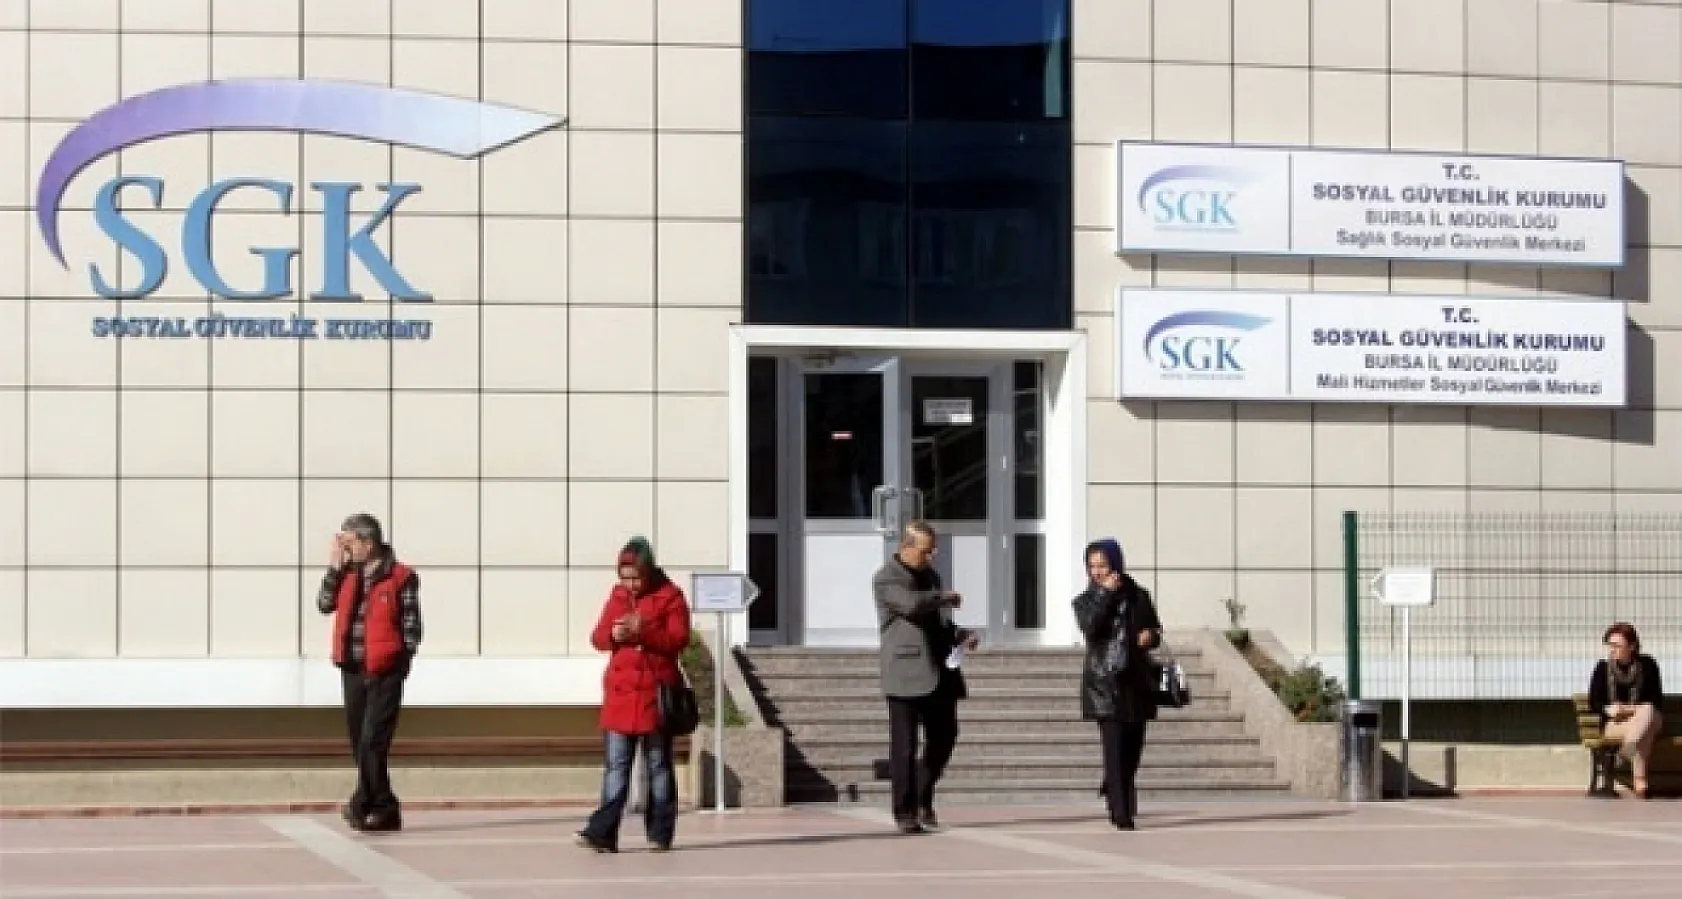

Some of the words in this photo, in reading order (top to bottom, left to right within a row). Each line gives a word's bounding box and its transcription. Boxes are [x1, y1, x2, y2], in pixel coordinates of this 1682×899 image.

[1442, 162, 1480, 180] T.C.
[1153, 188, 1239, 226] SGK
[1313, 182, 1395, 202] SOSYAL
[1402, 184, 1508, 206] GÜVENLİK
[1516, 190, 1606, 209] KURUMU
[1365, 209, 1425, 226] BURSA
[89, 176, 433, 302] SGK
[1441, 305, 1480, 323] T.C.
[92, 316, 191, 339] SOSYAL
[196, 311, 319, 339] GÜVENLİK
[323, 318, 434, 341] KURUMU
[1312, 328, 1393, 347] SOSYAL
[1399, 328, 1508, 349] GÜVENLİK
[1513, 333, 1606, 351] KURUMU
[1160, 336, 1245, 371] SGK
[1365, 353, 1425, 369] BURSA
[1316, 373, 1349, 389] Mali
